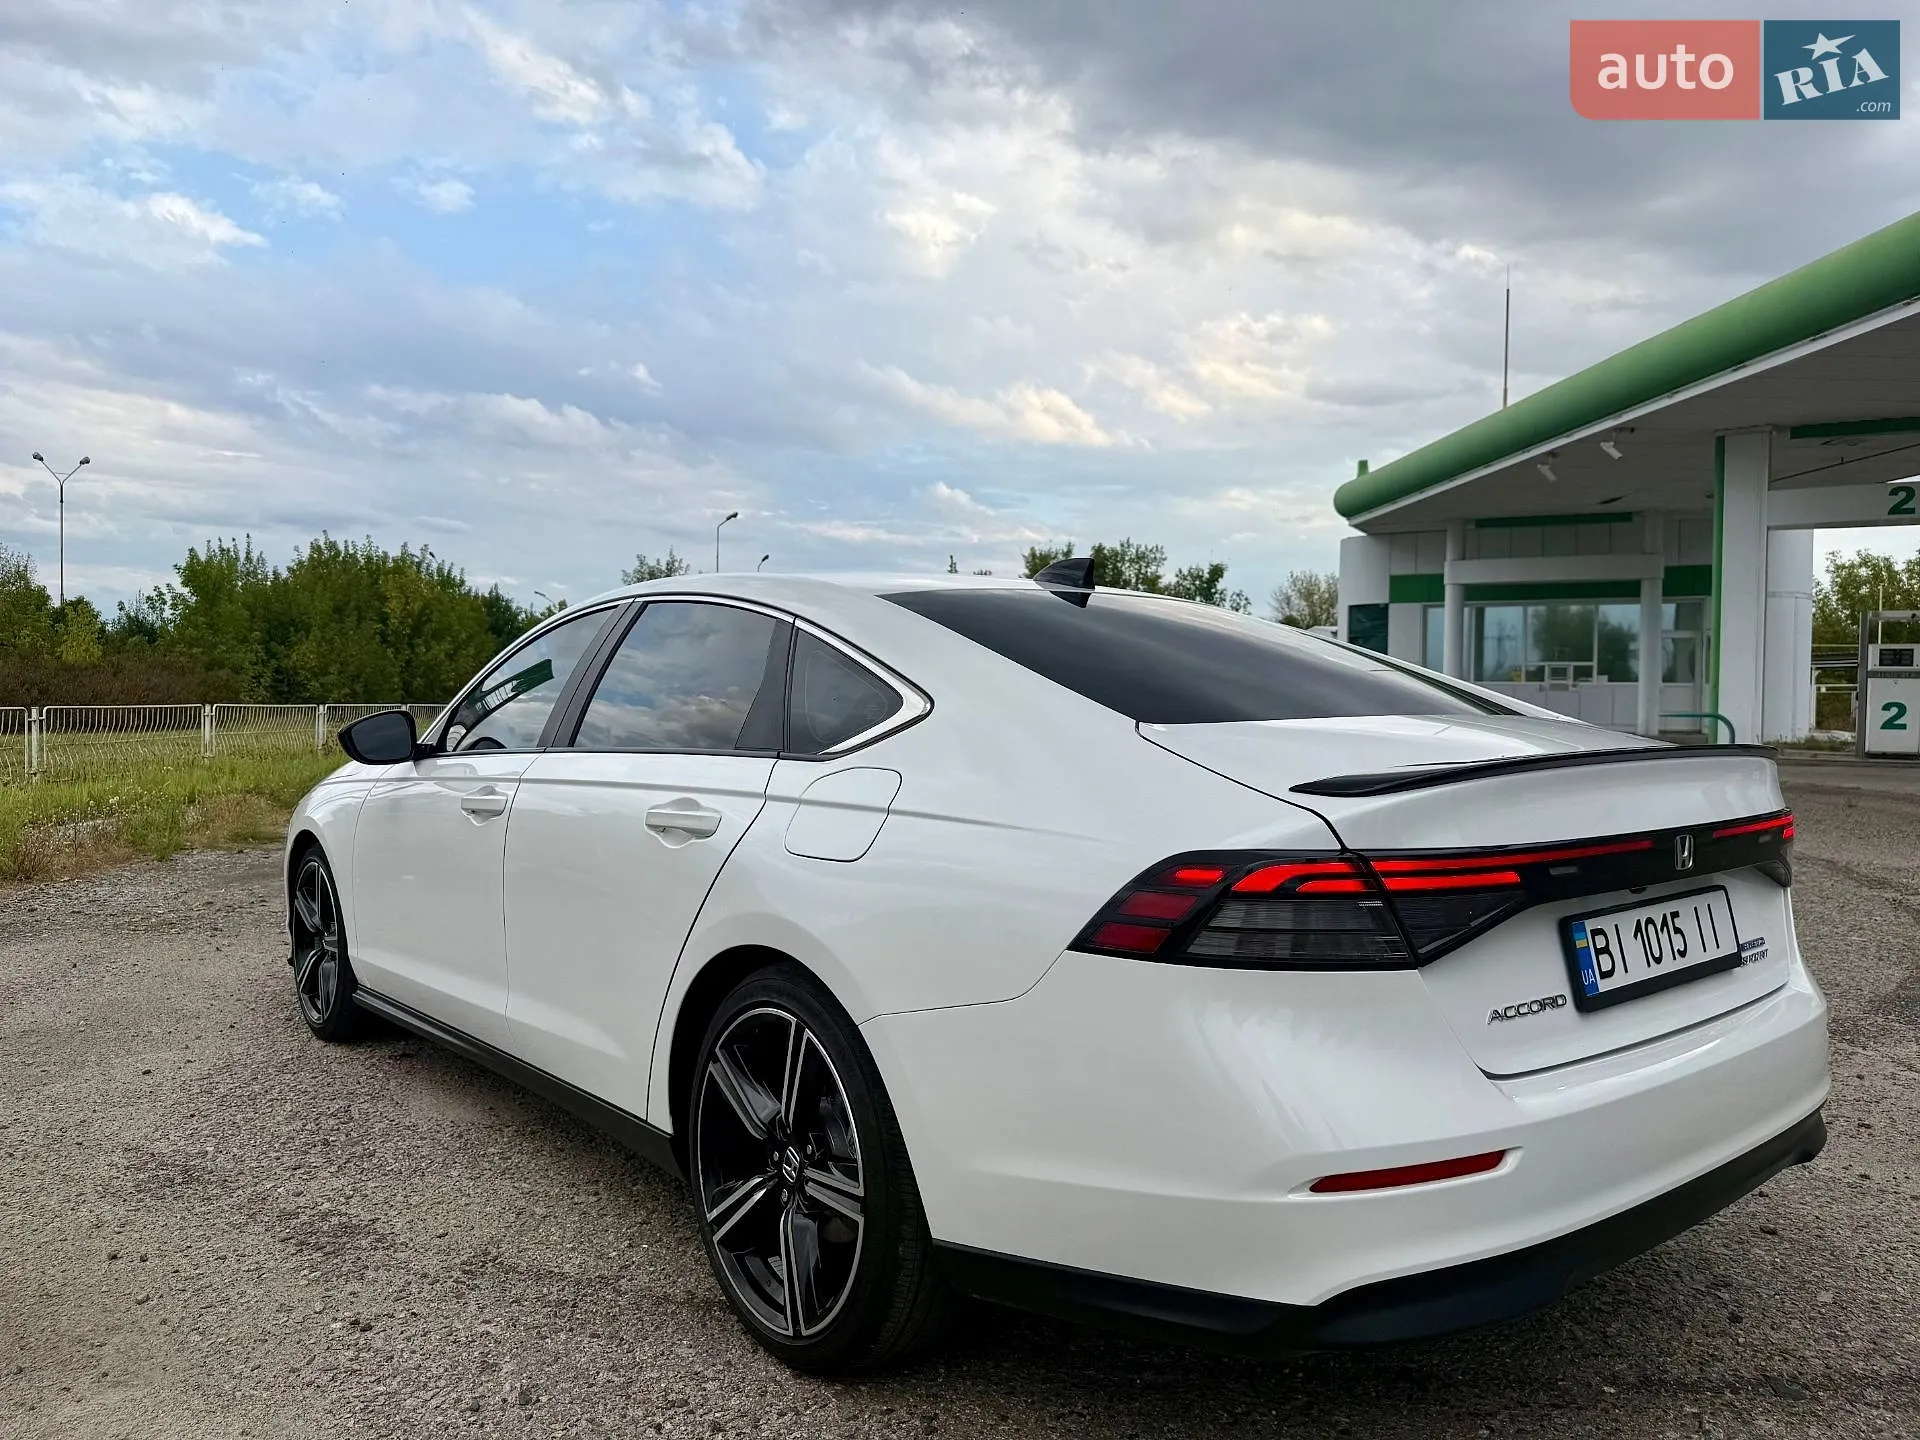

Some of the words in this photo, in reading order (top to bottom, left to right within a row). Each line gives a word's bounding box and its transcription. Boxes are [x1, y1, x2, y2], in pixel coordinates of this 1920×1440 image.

[1887, 486, 1916, 515] 2
[1879, 701, 1907, 730] 2
[1590, 924, 1628, 980] BI
[1632, 910, 1688, 968] 1015
[1693, 903, 1720, 953] II
[1582, 969, 1596, 986] UA
[1487, 994, 1567, 1025] ACCORD
